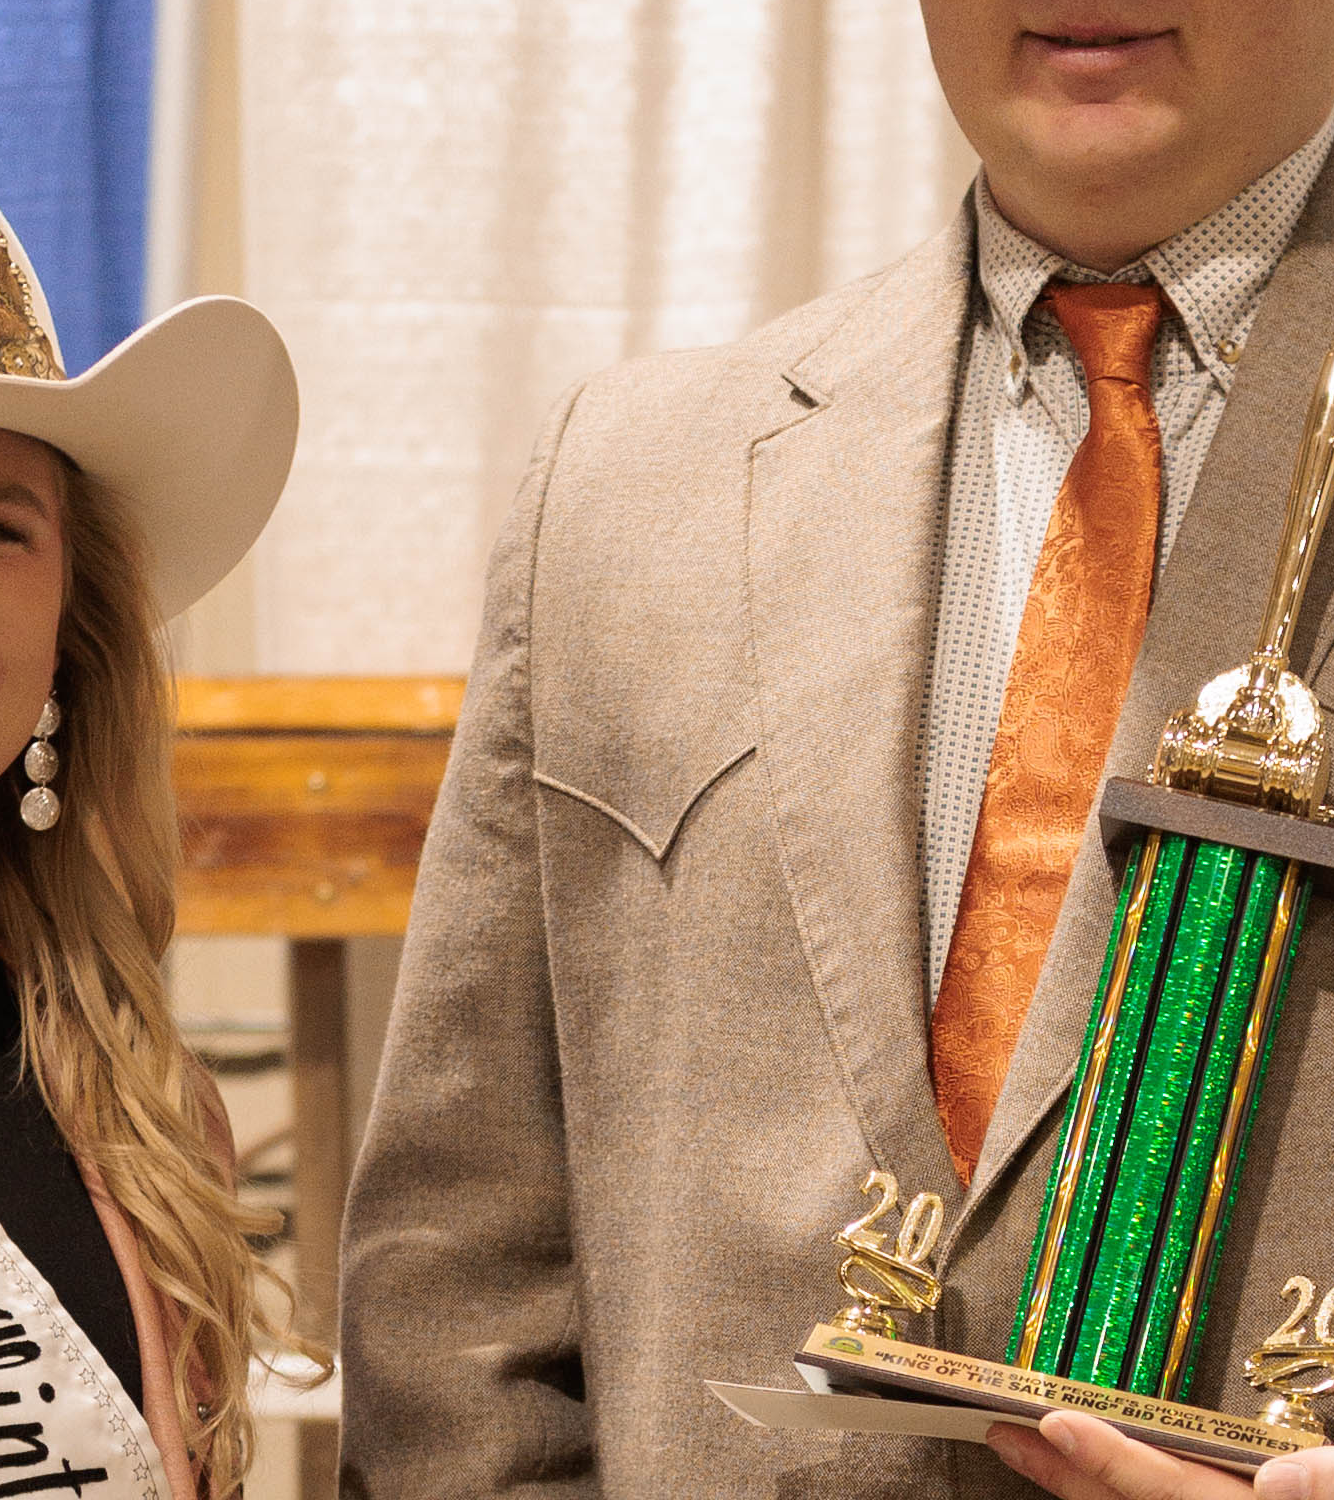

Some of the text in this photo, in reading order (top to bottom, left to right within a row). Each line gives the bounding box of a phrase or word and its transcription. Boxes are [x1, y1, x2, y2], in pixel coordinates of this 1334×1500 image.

[836, 1169, 944, 1265] 20
[915, 1352, 1269, 1436] ND WINTER SHOW PEOPLE'S CHOICE AWARD
[935, 1364, 961, 1377] OF
[967, 1371, 1004, 1388] THE
[1007, 1380, 1062, 1400] SALE
[1121, 1405, 1156, 1421] BID
[1159, 1414, 1208, 1434] CALL
[1212, 1426, 1305, 1453] CONTEST
